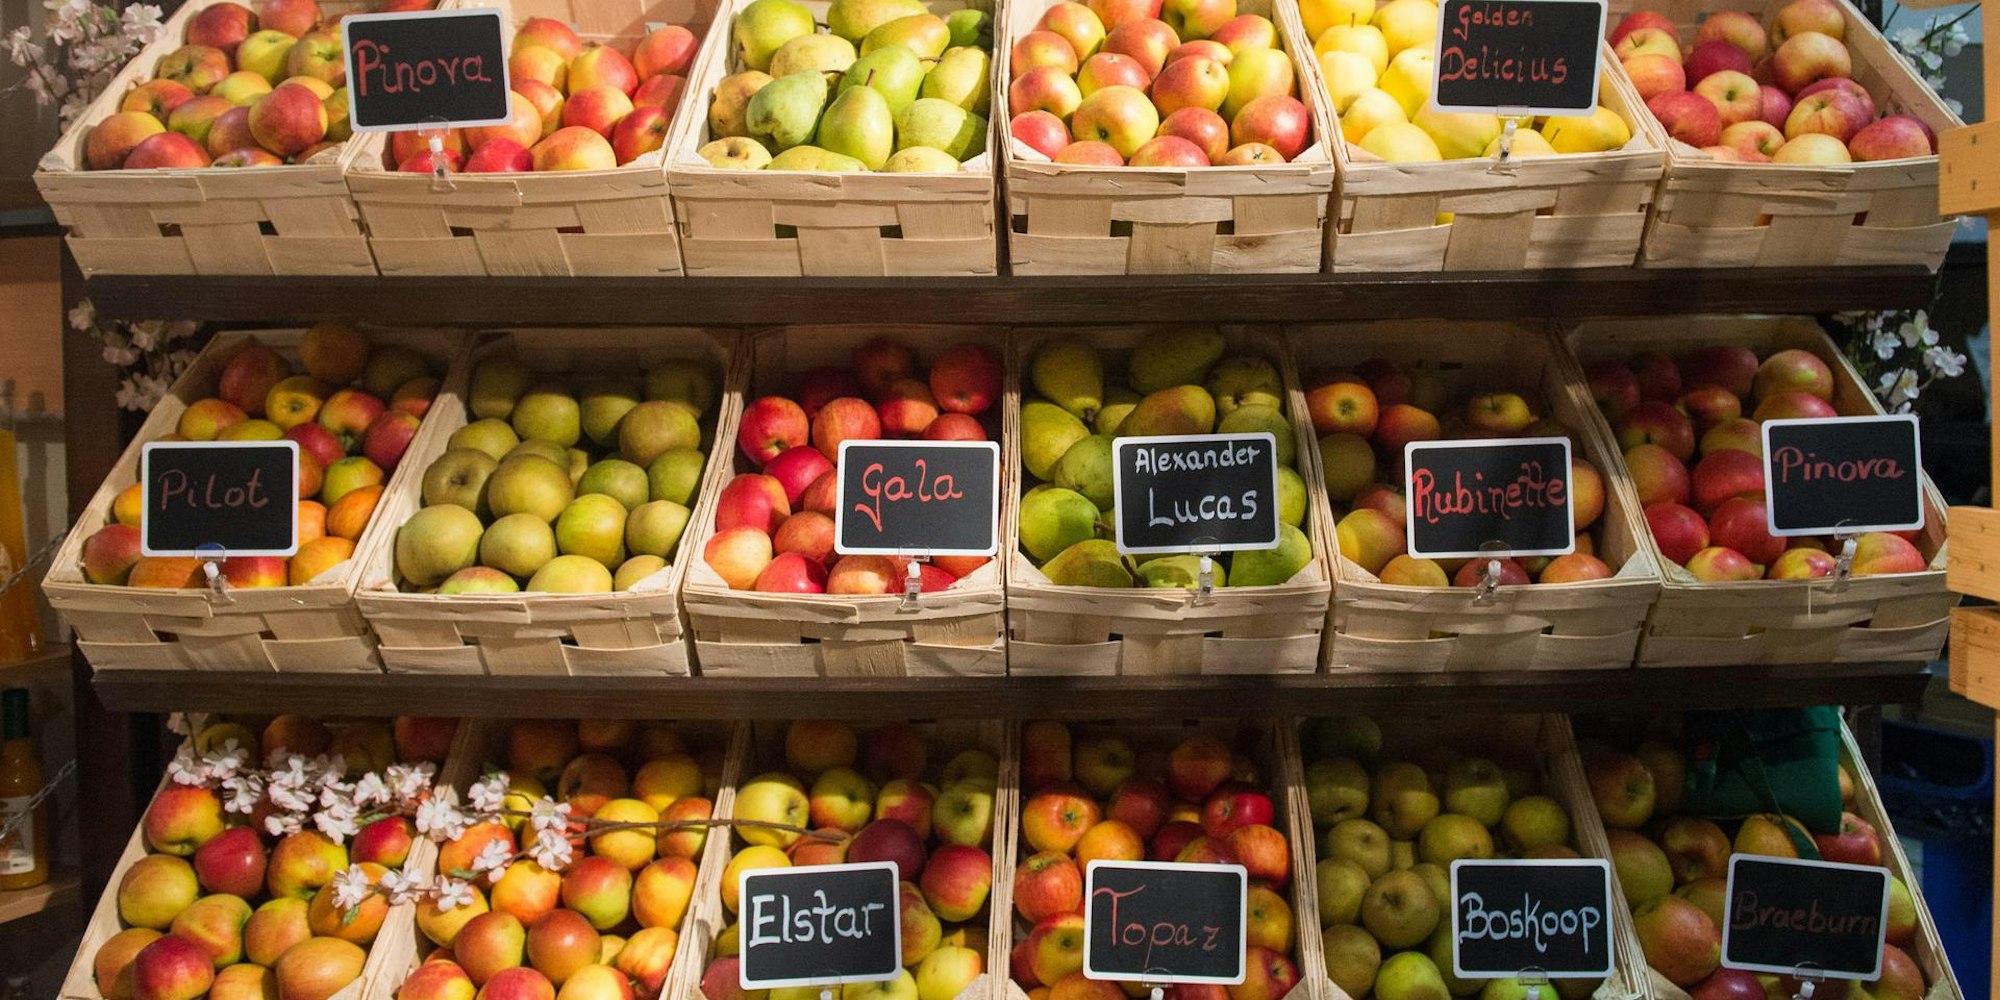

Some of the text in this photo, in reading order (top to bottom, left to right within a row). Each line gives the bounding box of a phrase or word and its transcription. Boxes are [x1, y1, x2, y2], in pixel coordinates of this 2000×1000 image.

[1453, 3, 1533, 41] Golden
[352, 39, 492, 97] Pinova
[1440, 44, 1568, 85] Delicius
[1135, 440, 1261, 476] Alexander
[1773, 446, 1904, 483] Pinova
[158, 468, 269, 511] Pilot
[855, 459, 963, 533] Gala
[1149, 487, 1257, 527] Lucas
[1413, 460, 1566, 524] Rubinette
[749, 889, 885, 948] Elstar
[1093, 884, 1220, 968] Topaz
[1459, 891, 1600, 955] Boskoop
[1731, 891, 1877, 936] Braeburn
